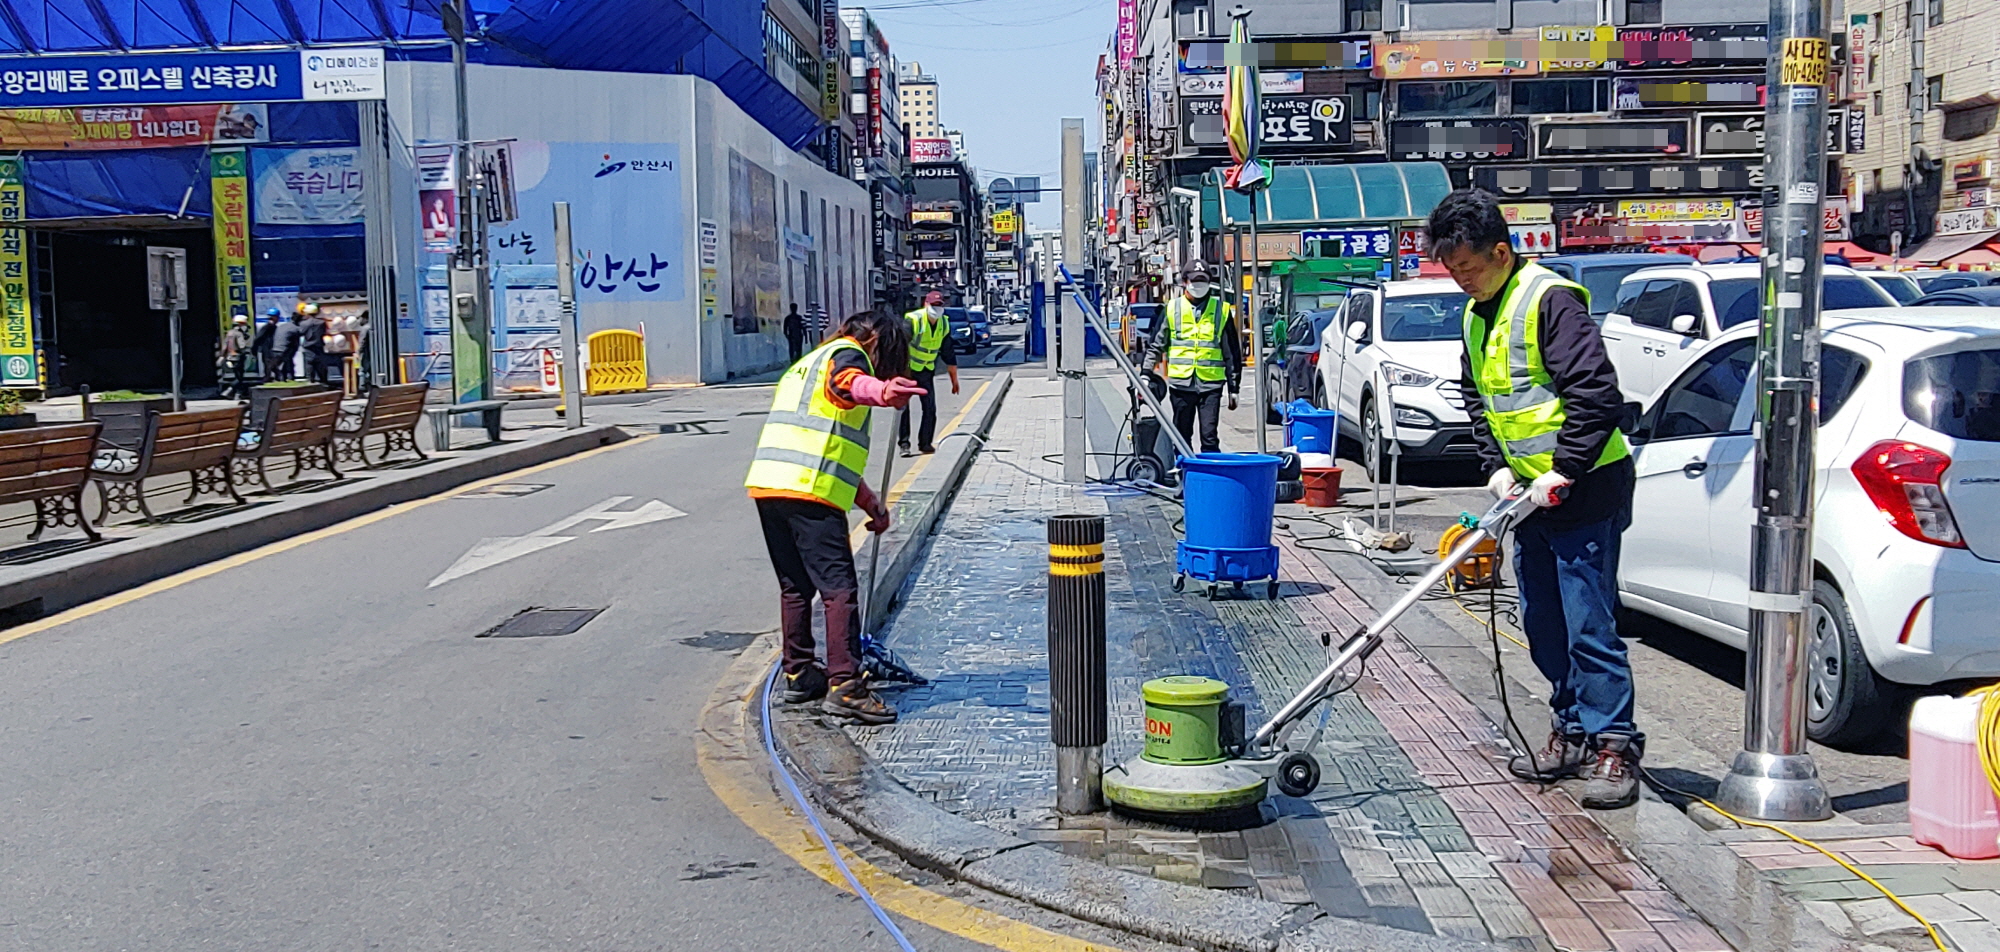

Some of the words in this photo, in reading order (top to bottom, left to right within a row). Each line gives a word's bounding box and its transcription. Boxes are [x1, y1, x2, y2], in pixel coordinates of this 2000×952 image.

[1785, 40, 1827, 61] 사다리
[0, 69, 91, 95] 앙리베로
[97, 67, 184, 91] 오피스텔
[190, 64, 278, 90] 신축공사
[137, 121, 201, 138] 너나없다
[1260, 116, 1314, 142] 포토
[631, 160, 673, 171] 안산시
[915, 168, 959, 177] HOTEL
[286, 171, 364, 194] 죽습니다
[1, 191, 20, 256] 작업시작
[224, 183, 246, 258] 추락재해
[3, 262, 22, 277] 전
[581, 252, 669, 293] 안산
